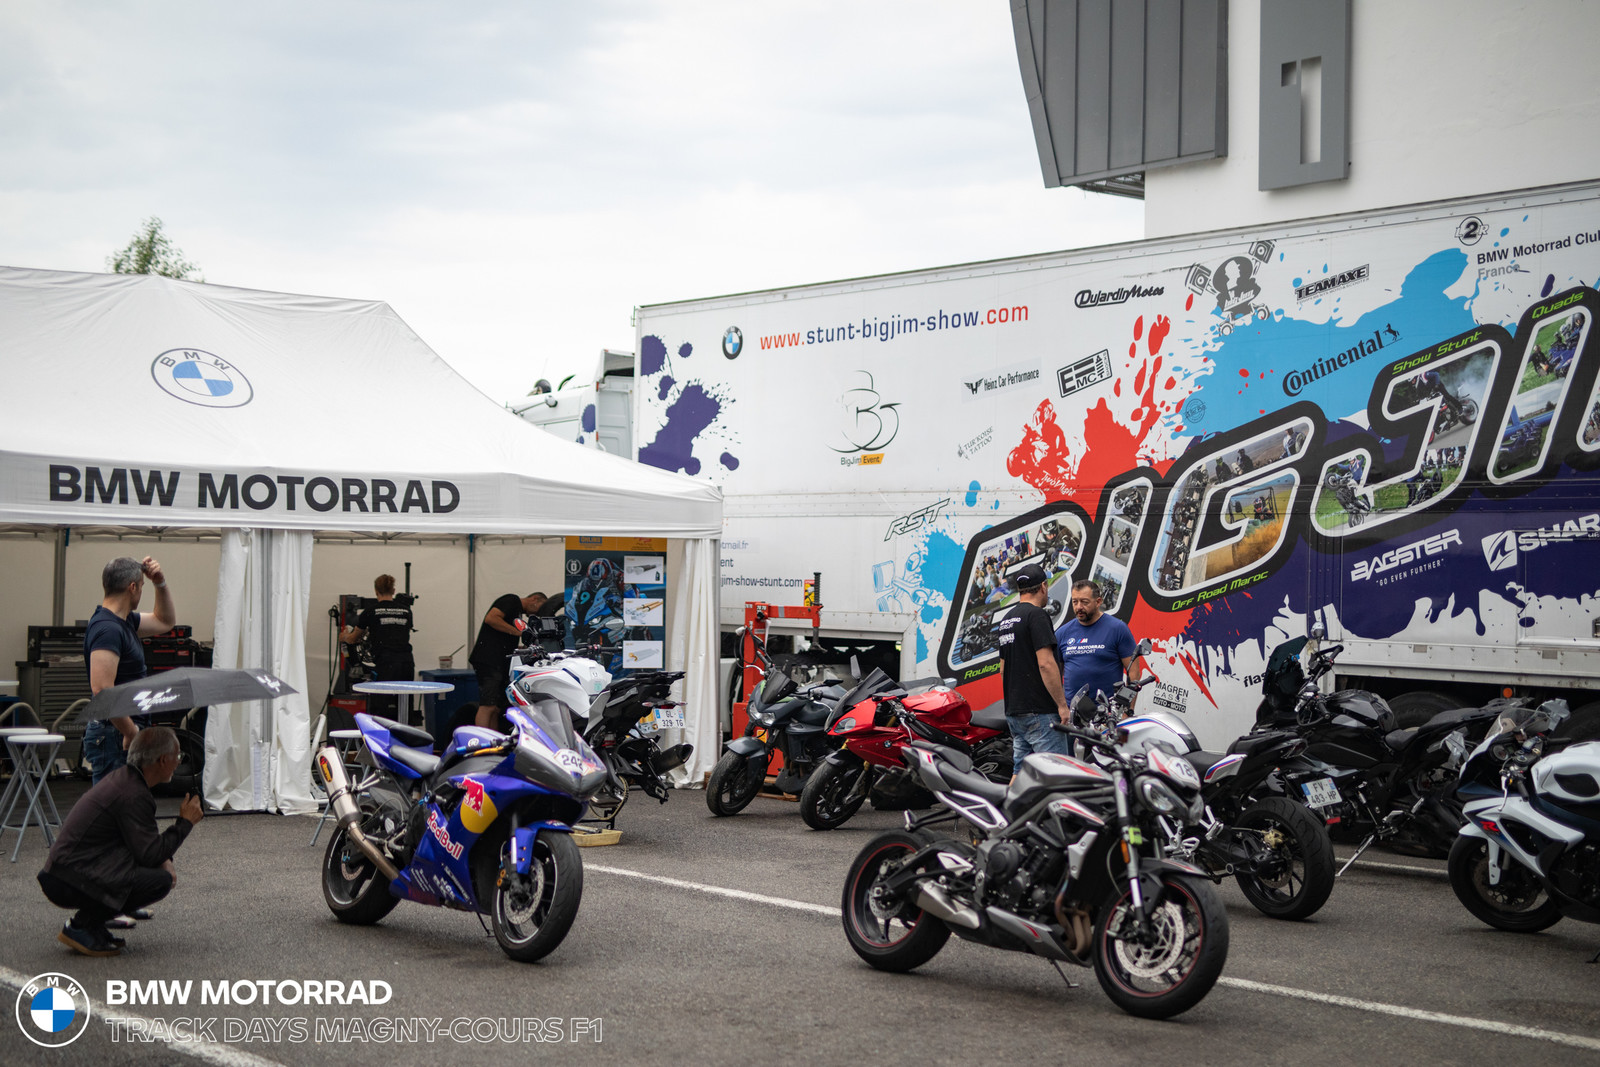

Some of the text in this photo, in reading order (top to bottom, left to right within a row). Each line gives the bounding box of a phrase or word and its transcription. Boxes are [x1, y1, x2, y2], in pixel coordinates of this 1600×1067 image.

[1281, 56, 1322, 164] 1
[1477, 248, 1509, 265] BMW
[1513, 236, 1571, 258] Motorrad
[1478, 263, 1520, 279] France
[1532, 292, 1584, 319] Quads
[760, 305, 1029, 350] www.stunt-bigjim-show.com
[160, 352, 230, 370] BMW
[1282, 330, 1384, 397] Continental
[1392, 331, 1482, 375] Show Stunt
[984, 368, 1040, 391] Heinz Car Performance
[840, 456, 880, 467] BigJim Event
[48, 464, 461, 514] BMW MOTORRAD
[884, 498, 950, 541] RST
[720, 540, 749, 550] tmail.fr
[1350, 529, 1463, 582] BAGSTER
[1172, 571, 1269, 611] Off Road Maroc
[1390, 571, 1407, 583] EVEN
[1154, 689, 1187, 705] CASSE
[1155, 681, 1189, 698] MAGREN
